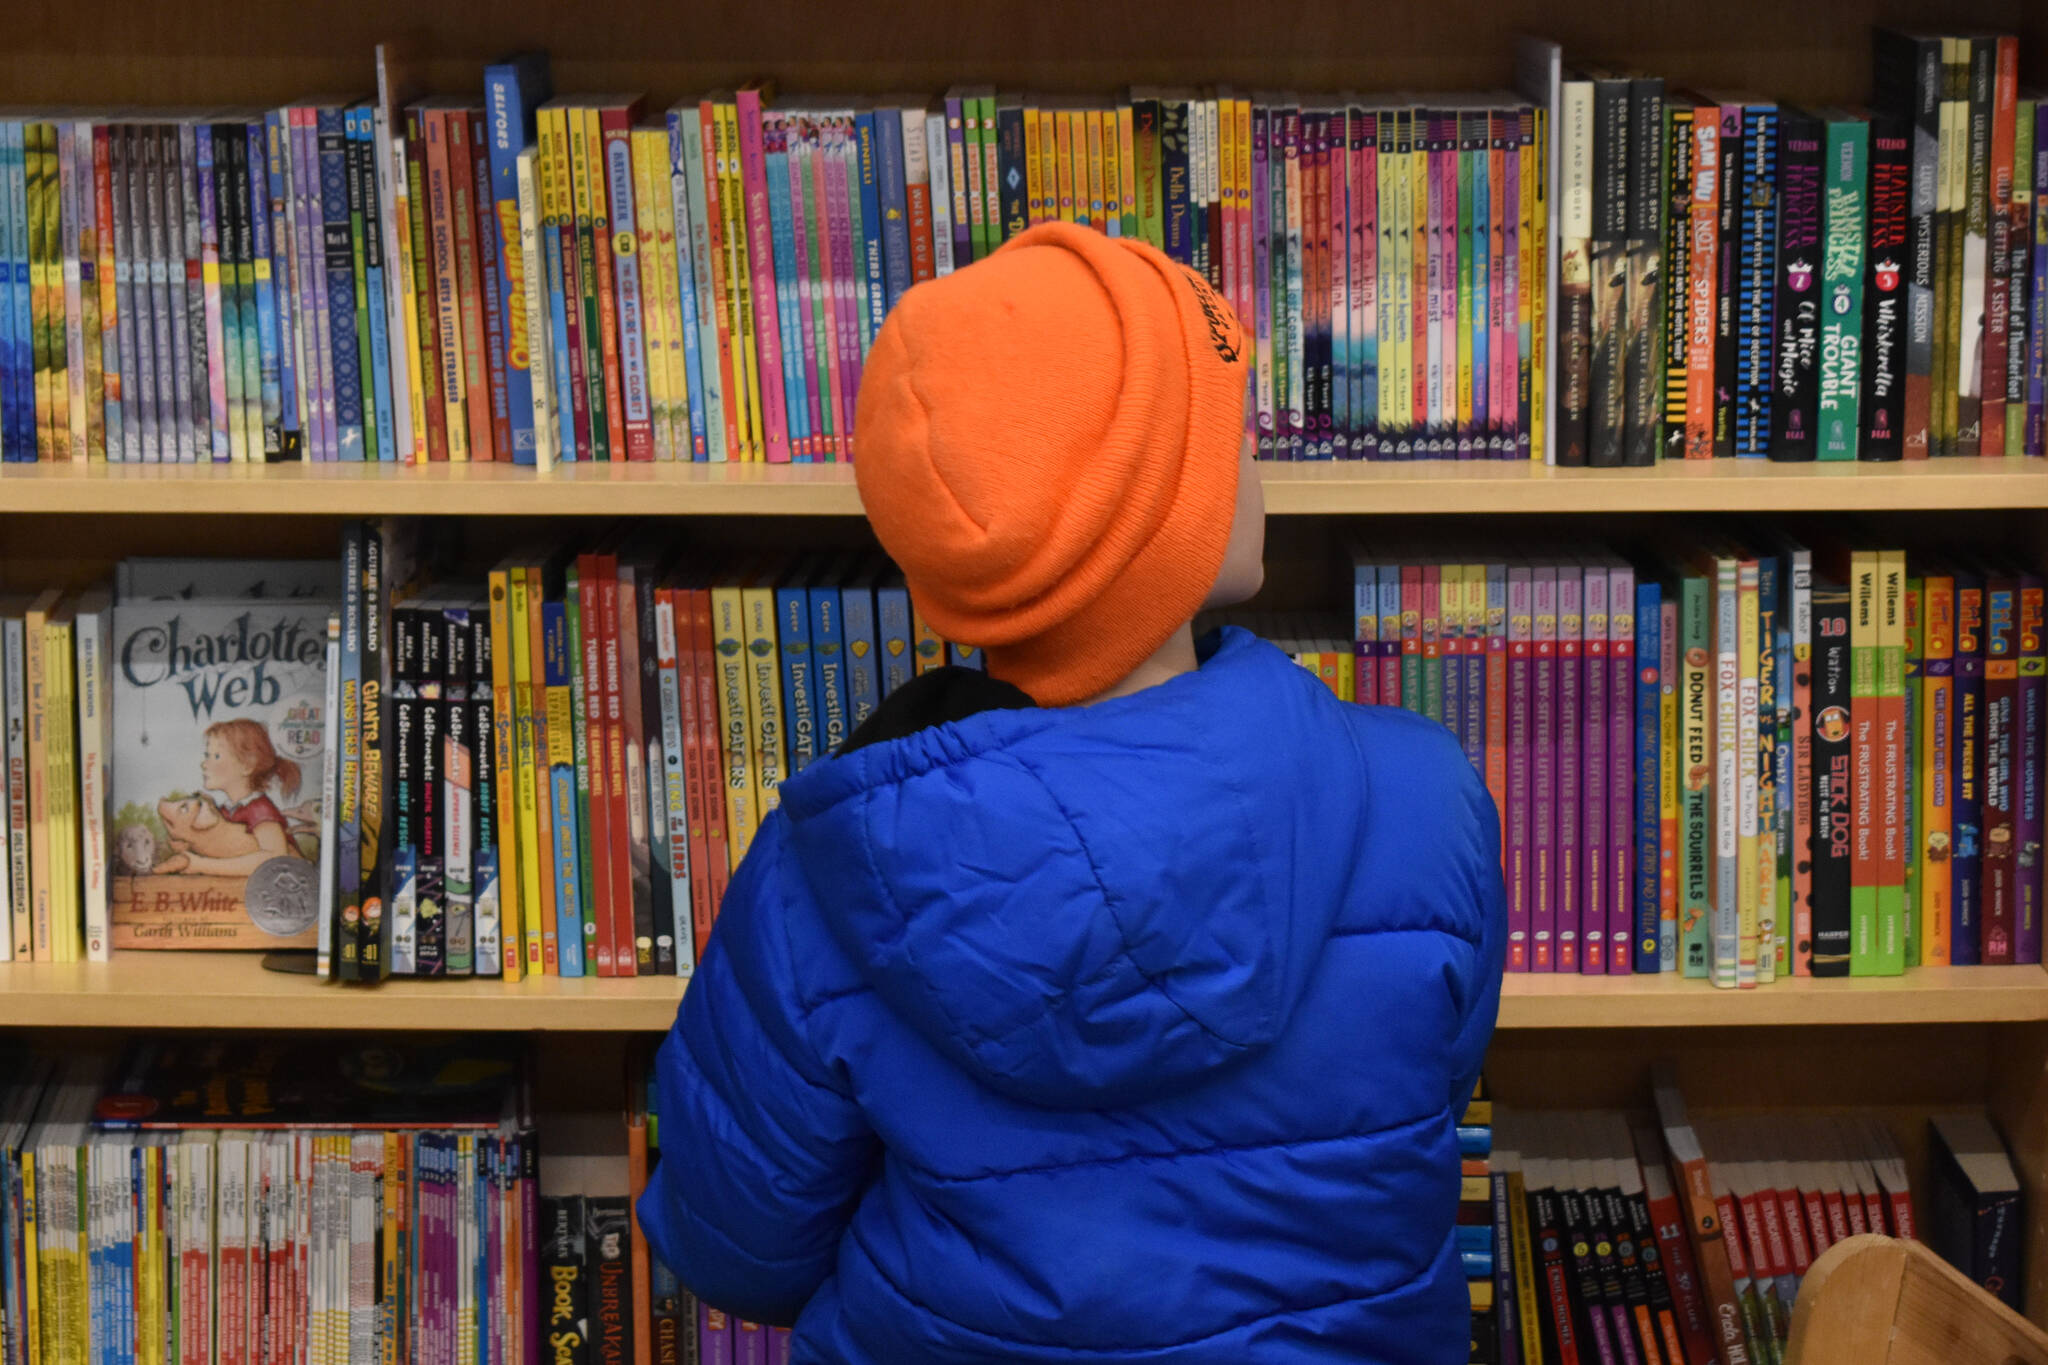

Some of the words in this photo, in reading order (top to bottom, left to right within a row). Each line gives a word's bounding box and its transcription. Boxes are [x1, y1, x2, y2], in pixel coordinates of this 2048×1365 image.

[493, 82, 509, 150] SELFORS
[1651, 96, 1660, 120] EGG
[860, 126, 872, 185] SPINELLI
[1650, 126, 1659, 167] MARKS
[1696, 125, 1716, 166] SAM
[432, 170, 445, 220] WAYSIDE
[1169, 166, 1184, 200] Bella
[1650, 172, 1658, 194] THE
[1695, 170, 1716, 201] WU
[1919, 164, 1932, 206] LULU'S
[1996, 166, 2008, 198] LULU
[912, 188, 924, 227] WHEN
[1648, 200, 1657, 230] SPOT
[1754, 210, 1762, 238] SAMMY
[1784, 164, 1802, 249] PRINCESS
[1801, 165, 1820, 247] HAMSTER
[1872, 163, 1891, 248] PRINCESS
[1890, 164, 1908, 247] HAMSTER
[1996, 204, 2008, 216] IS
[1171, 204, 1184, 248] Donna
[1676, 220, 1685, 248] SAMMY
[1695, 219, 1713, 254] NOT
[1824, 187, 1847, 282] PRINCESS
[1840, 187, 1862, 279] HAMSTER
[435, 226, 448, 274] SCHOOL
[868, 239, 880, 279] THIRD
[915, 236, 927, 262] YOU
[1676, 250, 1684, 274] KEYES
[1753, 242, 1762, 267] KEYES
[1916, 214, 1931, 285] MYSTERIOUS
[1993, 221, 2007, 272] GETTING
[2012, 248, 2026, 269] The
[440, 278, 452, 302] GETS
[1675, 276, 1684, 292] AND
[1752, 270, 1762, 287] AND
[1752, 289, 1760, 304] THE
[1992, 278, 2003, 287] A
[2009, 272, 2025, 312] Legend
[870, 283, 883, 324] GRADE
[1675, 295, 1684, 309] THE
[1693, 279, 1709, 344] SPIDERS
[1721, 297, 1730, 321] ENEMY
[1751, 308, 1760, 323] ART
[1796, 300, 1816, 322] Of
[1914, 294, 1928, 344] MISSION
[1991, 292, 2004, 333] SISTER
[442, 316, 455, 347] LITTLE
[1674, 313, 1683, 337] HOTEL
[1720, 323, 1729, 336] SPY
[1751, 326, 1760, 336] OF
[1783, 319, 1796, 340] and
[2010, 315, 2024, 327] of
[1674, 339, 1682, 361] THIEF
[1750, 339, 1760, 386] DECEPTION
[1798, 328, 1816, 370] Mice
[1821, 323, 1841, 410] TROUBLE
[1875, 299, 1897, 397] Whiskerella
[2008, 330, 2024, 399] Thunderfoot
[445, 351, 458, 403] STRANGER
[1778, 342, 1799, 396] Magic
[1839, 335, 1858, 399] GIANT
[348, 540, 357, 592] AGUIRRE
[368, 540, 377, 590] AGUIRRE
[348, 594, 356, 602] &
[368, 593, 377, 602] &
[1860, 573, 1872, 626] Willems
[1887, 572, 1898, 626] Willems
[347, 604, 357, 652] ROSADO
[368, 605, 377, 652] ROSADO
[821, 600, 831, 633] Green
[1799, 600, 1808, 634] Tabor
[1819, 617, 1846, 637] 10
[84, 638, 93, 678] BRENDA
[587, 638, 598, 692] TURNING
[606, 638, 618, 692] TURNING
[1720, 660, 1734, 691] FOX
[1759, 610, 1774, 705] TIGER
[1827, 647, 1841, 694] Watson
[86, 680, 94, 718] WOODS
[176, 661, 281, 725] Web
[362, 679, 381, 741] GIANTS
[589, 696, 600, 719] RED
[608, 696, 619, 719] RED
[1538, 661, 1548, 753] BABY-SITTERS
[1690, 672, 1704, 722] DONUT
[1963, 693, 1974, 712] ALL
[2000, 697, 2010, 722] GINA
[287, 708, 320, 721] GREAT
[343, 679, 359, 755] MONSTERS
[591, 724, 600, 738] THE
[1721, 702, 1735, 753] CHICK
[1859, 720, 1870, 742] The
[1886, 720, 1896, 741] The
[1963, 715, 1973, 737] THE
[1988, 702, 1998, 740] BROKE
[287, 730, 320, 745] READ
[478, 705, 490, 779] CatStronauts:
[591, 739, 603, 771] GRAPHIC
[1689, 727, 1703, 763] FEED
[1798, 736, 1810, 759] SIR
[1988, 743, 1998, 764] THE
[2000, 733, 2009, 755] THE
[1538, 757, 1548, 797] LITTLE
[1963, 740, 1973, 780] PIECES
[1999, 757, 2009, 782] GIRL
[10, 757, 24, 801] CLAYTON
[342, 760, 360, 824] BEWARE!
[363, 749, 382, 818] BEWARE!
[480, 782, 490, 813] ROBOT
[593, 774, 603, 797] NOVEL
[1798, 764, 1809, 825] LADYBUG
[1831, 755, 1849, 807] STICK
[1857, 744, 1869, 825] FRUSTRATING
[1884, 744, 1896, 825] FRUSTRATING
[1962, 783, 1973, 800] FIT
[1987, 767, 1998, 806] WORLD
[1690, 792, 1703, 822] THE
[1998, 785, 2009, 811] WHO
[11, 804, 24, 830] BYRD
[480, 817, 490, 854] RESCUE
[1538, 801, 1548, 846] SISTER
[1758, 734, 1774, 907] NIGHTMARE
[1830, 812, 1850, 858] DOG
[14, 832, 24, 853] GOES
[1858, 828, 1870, 860] Book!
[1885, 828, 1895, 860] Book!
[1690, 823, 1703, 900] SQUIRRELS
[14, 856, 26, 914] UNDERGROUND
[130, 892, 149, 913] E.
[153, 891, 174, 913] B.
[179, 888, 239, 913] White
[133, 922, 173, 938] Garth
[178, 923, 238, 938] Williams
[1659, 1223, 1680, 1239] 11
[1671, 1247, 1681, 1265] THE
[550, 1265, 579, 1326] BOOK
[1550, 1267, 1563, 1302] ENOLA
